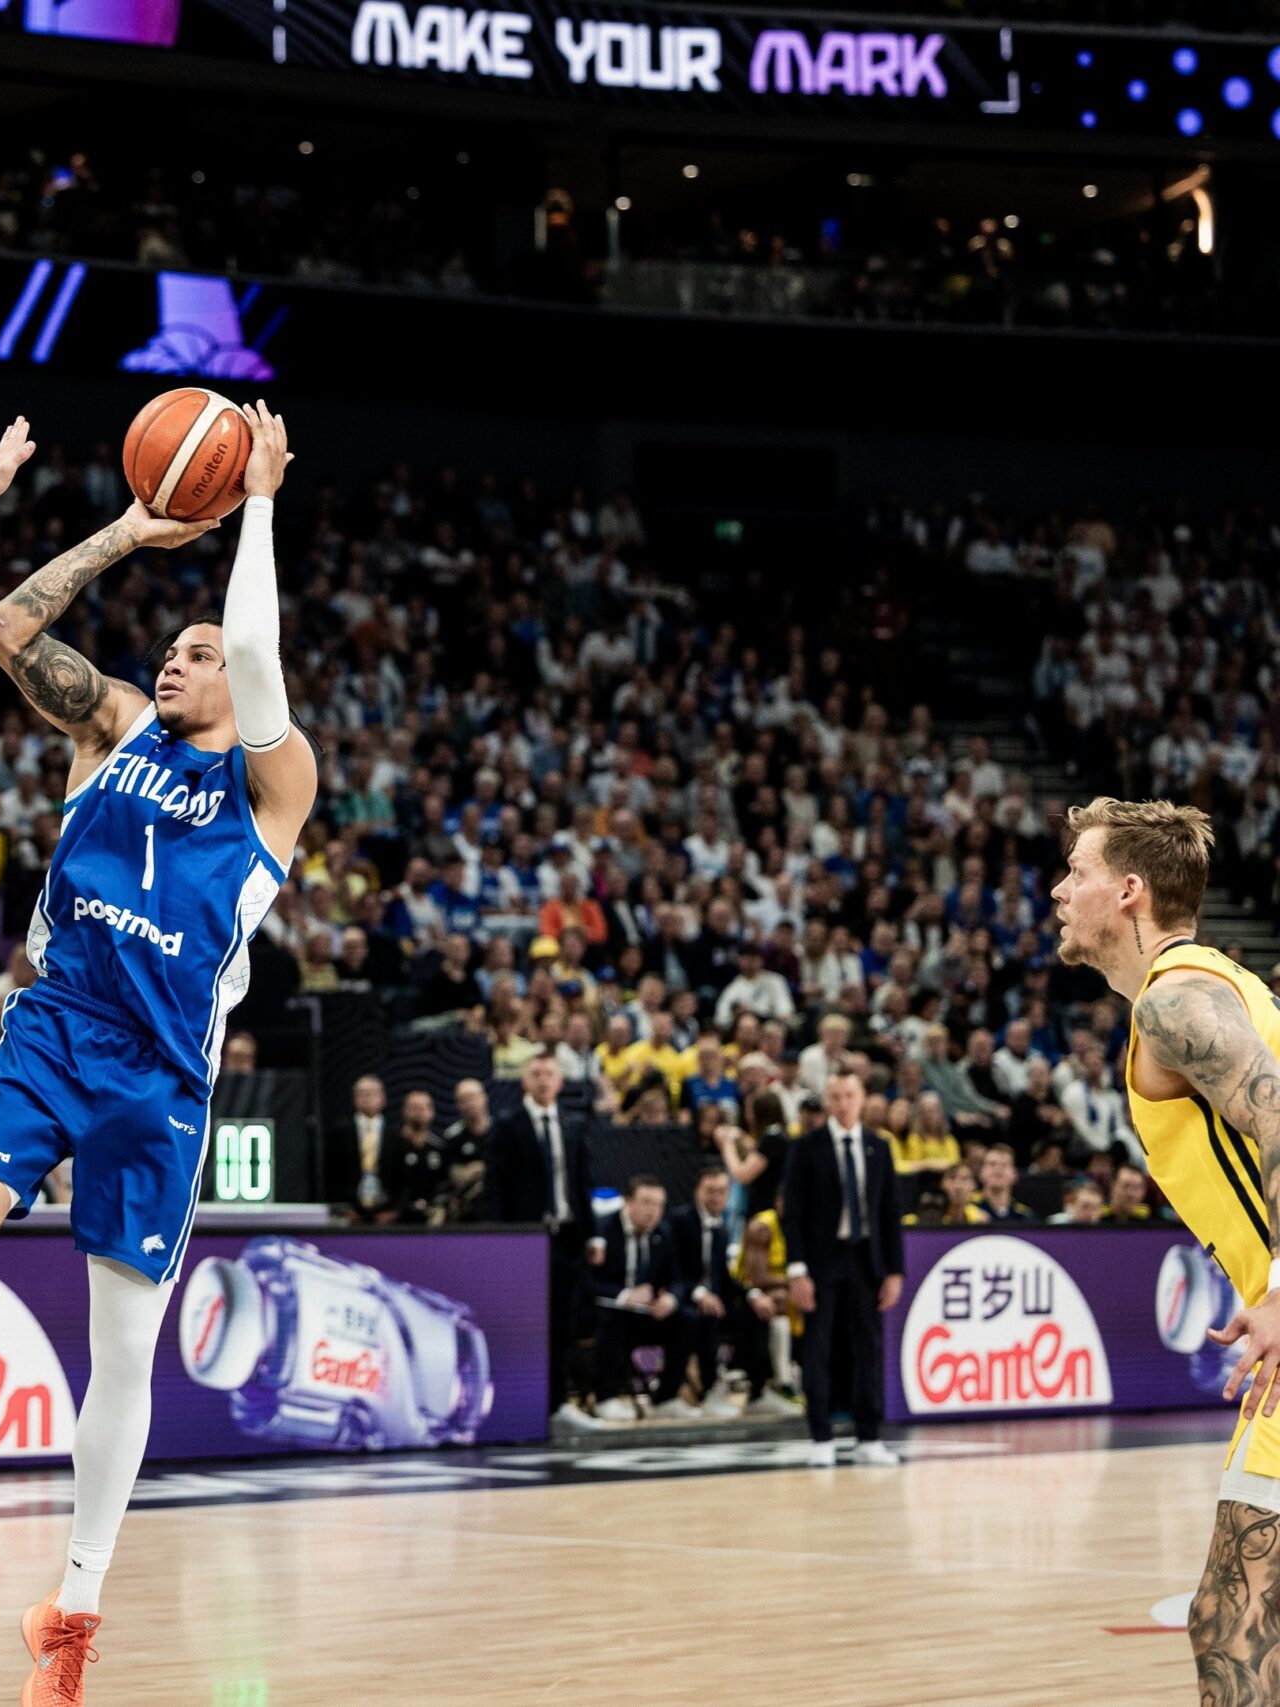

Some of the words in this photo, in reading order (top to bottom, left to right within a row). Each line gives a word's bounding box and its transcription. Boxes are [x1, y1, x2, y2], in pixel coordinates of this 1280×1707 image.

[352, 0, 532, 79] MAKE
[555, 18, 721, 92] YOUR
[749, 29, 948, 98] MARK
[191, 442, 229, 499] molten
[98, 752, 226, 828] FINLAND
[140, 824, 155, 891] 1
[74, 896, 184, 957] postnod
[941, 1264, 1055, 1321] 百岁山
[917, 1322, 1093, 1404] Ganten
